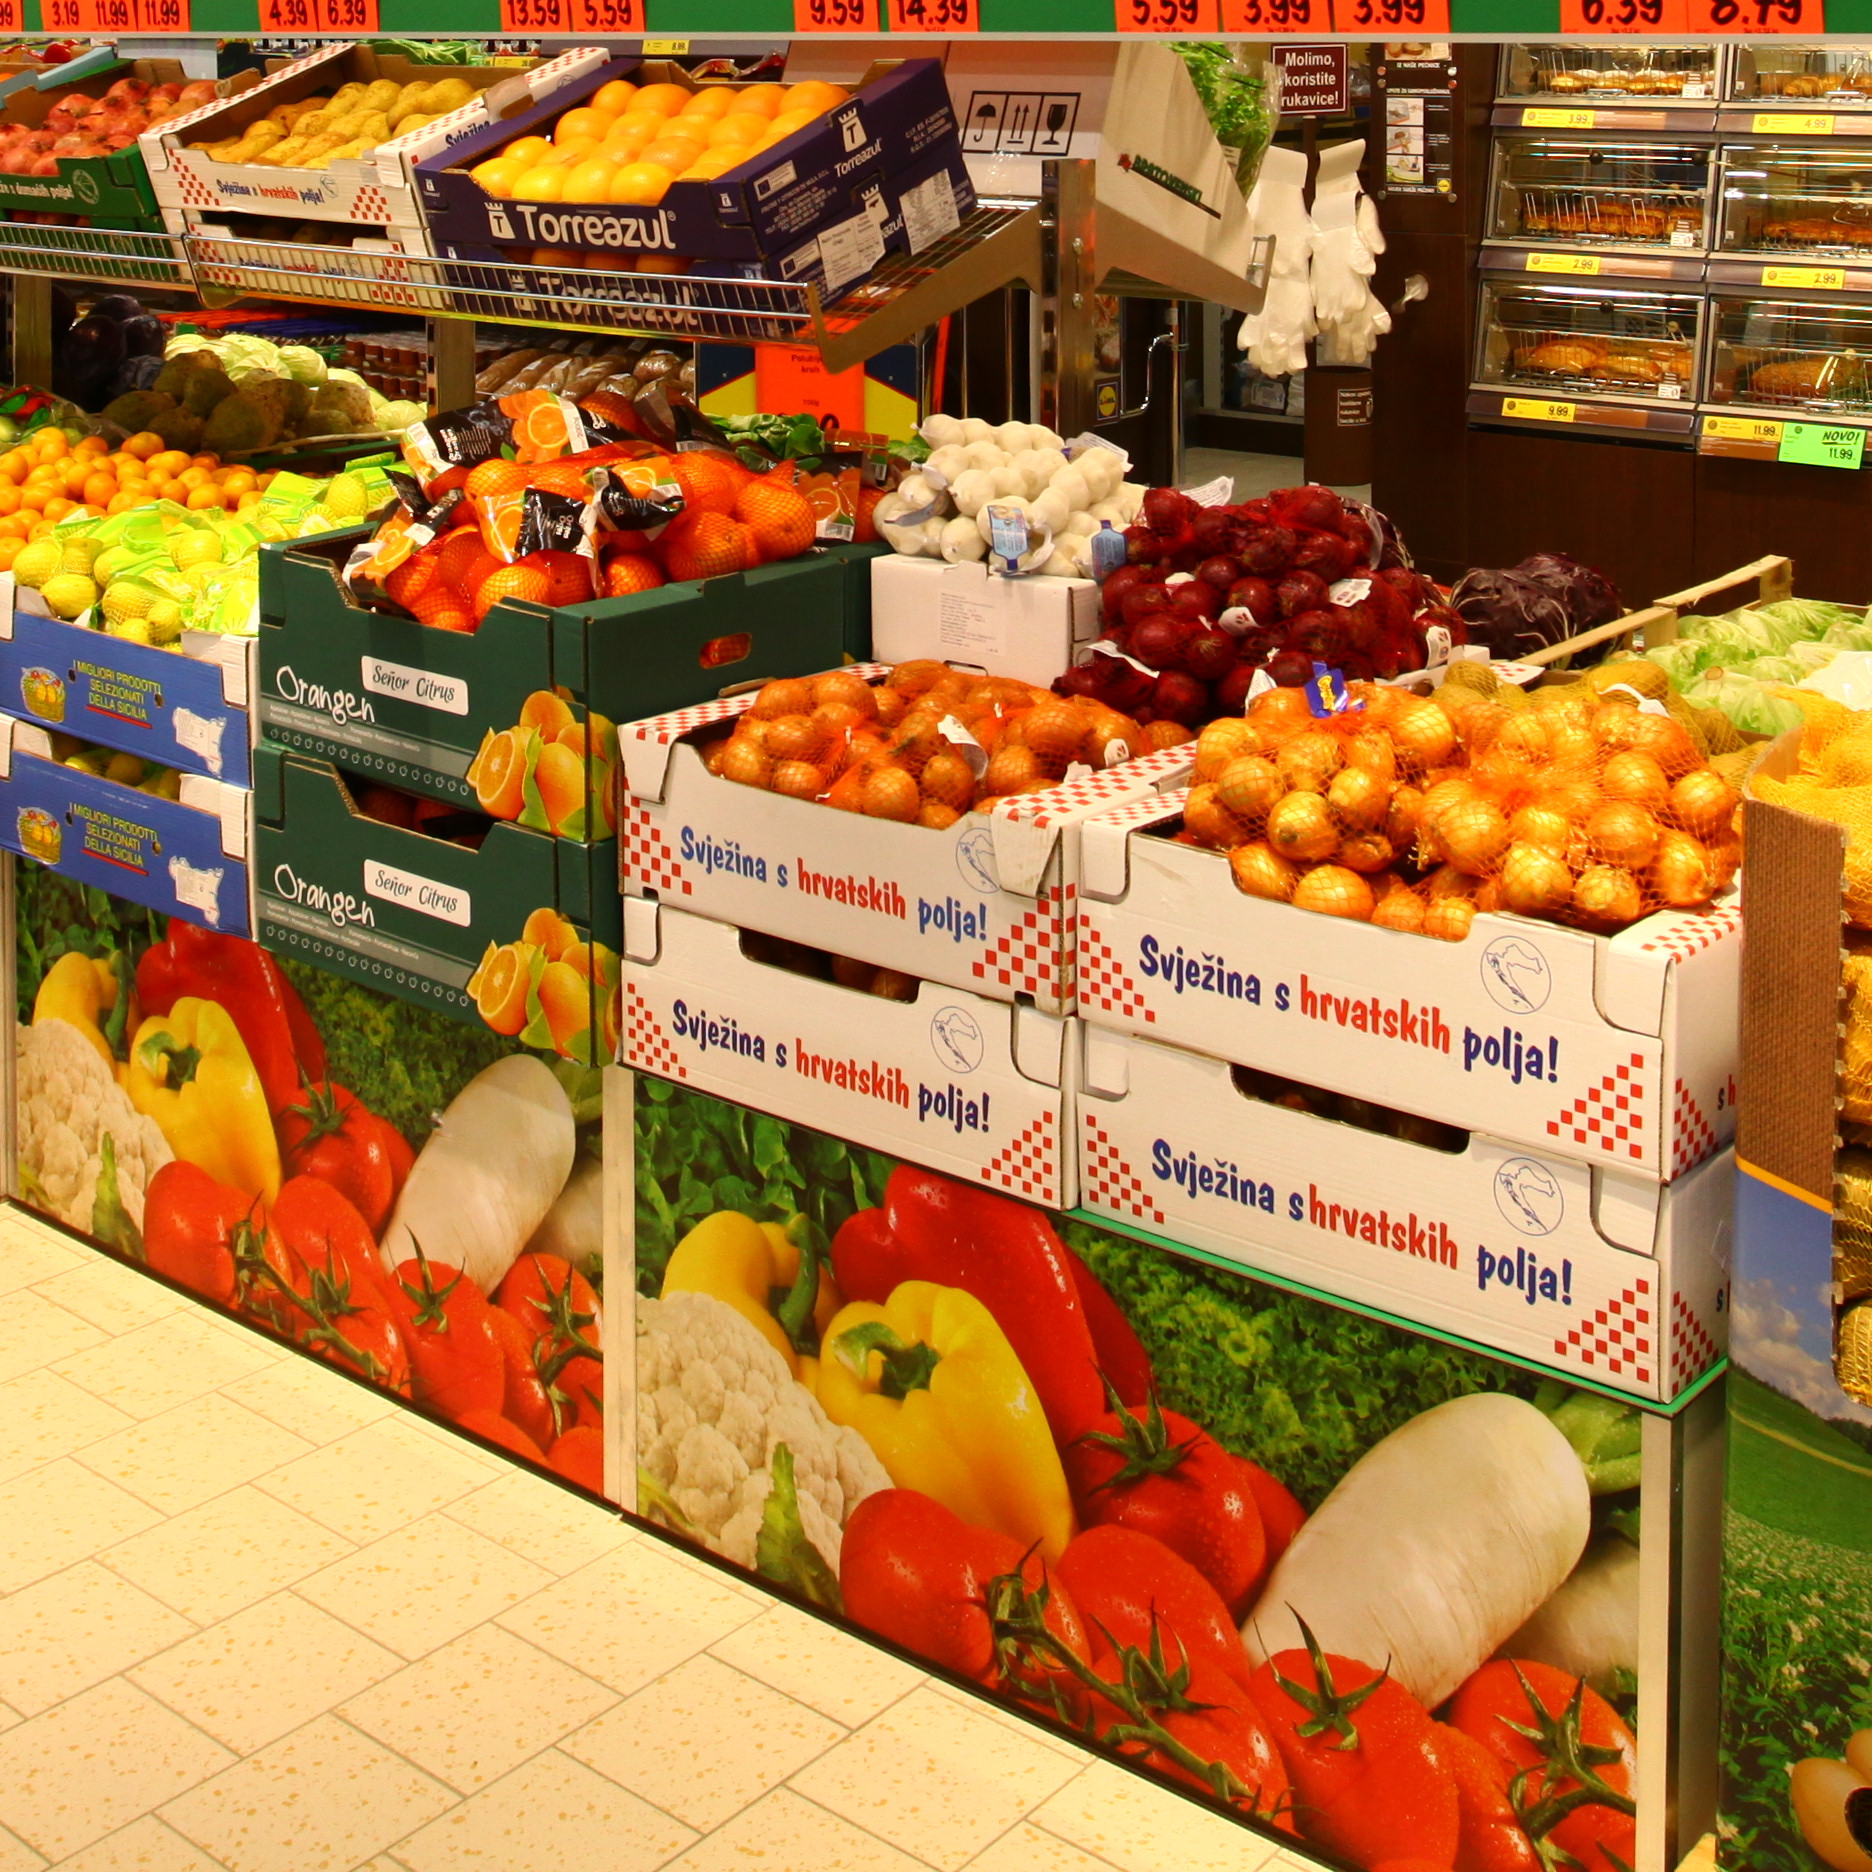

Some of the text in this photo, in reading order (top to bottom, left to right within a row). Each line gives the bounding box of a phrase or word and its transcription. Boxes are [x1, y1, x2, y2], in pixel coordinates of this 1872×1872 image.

[52, 0, 78, 25] 3.19
[145, 0, 179, 25] 11.99
[1285, 53, 1335, 67] Molimo,
[1285, 72, 1336, 86] koristite
[1282, 91, 1338, 107] rukavice!
[834, 138, 882, 177] Torreazul
[517, 205, 676, 249] Torreazul
[1822, 431, 1859, 444] NOVO!
[77, 660, 115, 685] MIGLIORI
[117, 671, 161, 695] PRODOTTI
[90, 678, 144, 704] SELEZIONATI
[372, 665, 455, 701] Señor Citrus
[88, 692, 147, 720] DELLA SICILIA
[276, 665, 375, 725] Orangen
[680, 826, 987, 941] Svježina s hrvatskih polja!
[1139, 933, 1558, 1084] Svježina s hrvatskih polja!
